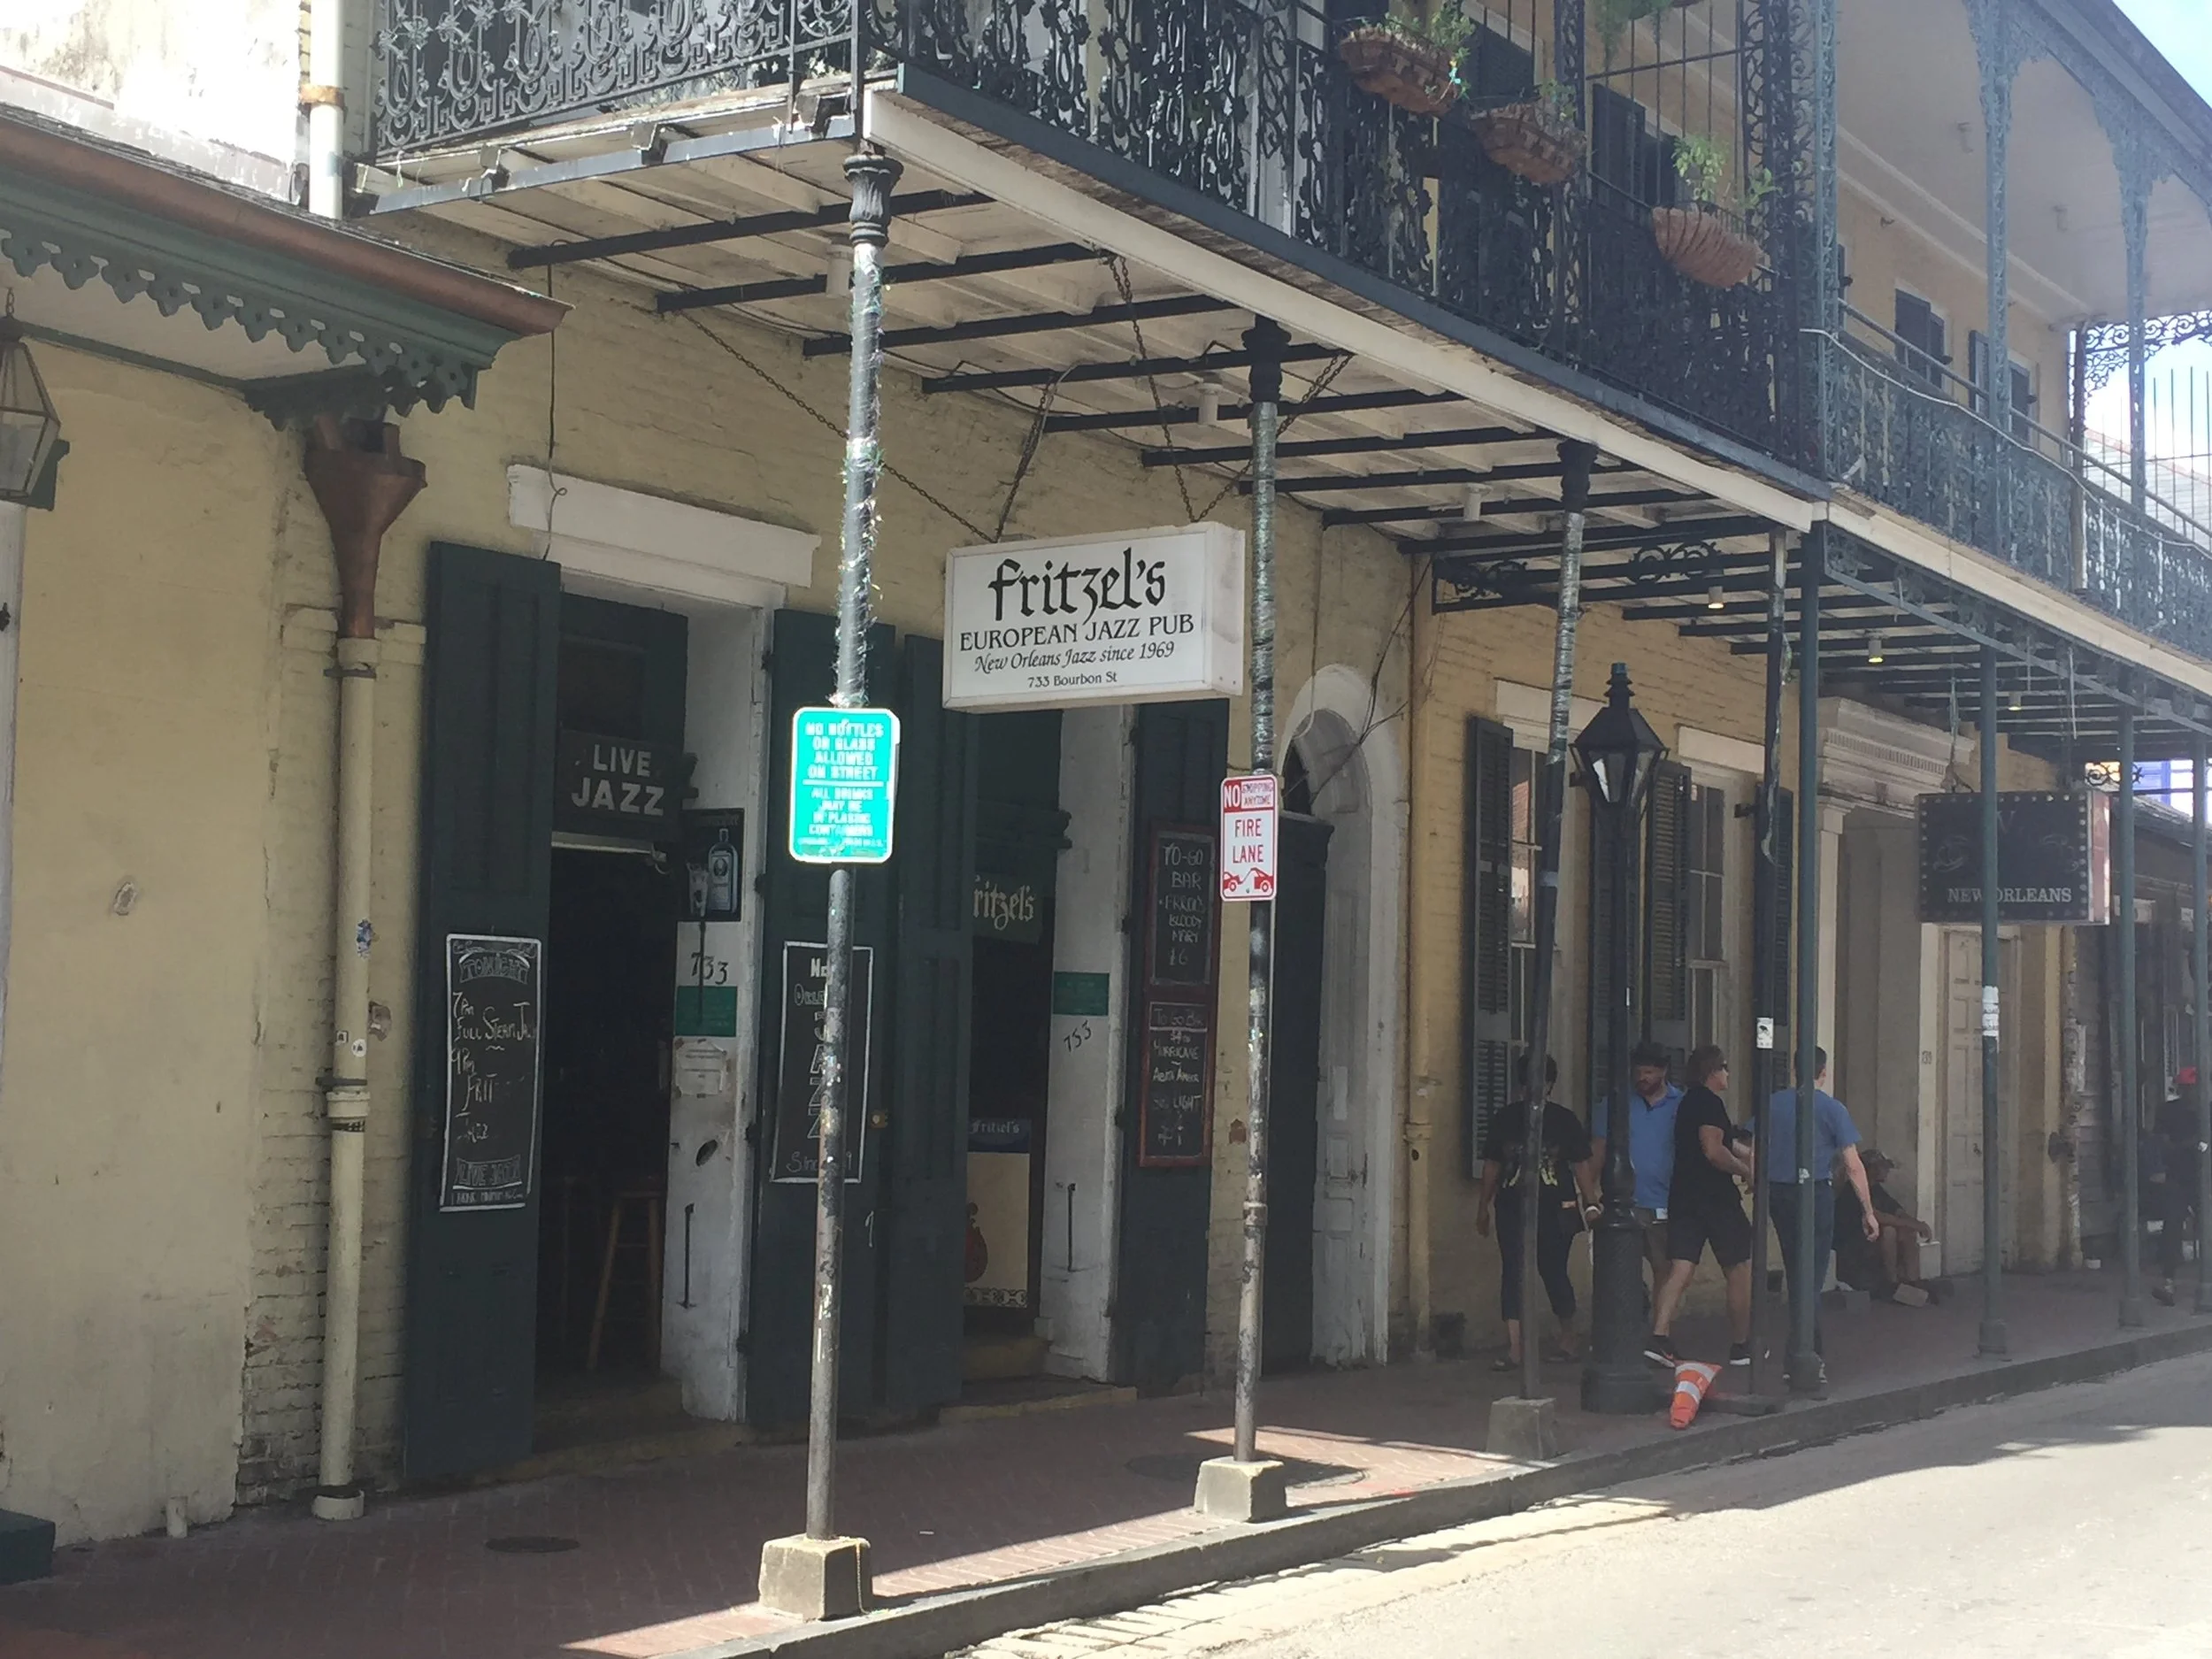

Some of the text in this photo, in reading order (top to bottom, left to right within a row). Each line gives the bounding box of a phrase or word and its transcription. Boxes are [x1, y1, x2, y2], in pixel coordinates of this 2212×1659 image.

[960, 613, 1194, 651] EUROPEAN JAZZ PUB
[974, 641, 1174, 674] New Orleans Jazz since 1969
[1027, 671, 1118, 688] 733 Bourbon St
[593, 743, 652, 777] LIVE
[815, 751, 874, 765] ALLOWED
[831, 766, 879, 780] STREET
[572, 777, 664, 817] JAZZ
[1225, 785, 1240, 809] NO
[1235, 818, 1262, 838] FIRE
[1233, 844, 1264, 864] LANE
[1171, 871, 1202, 890] BAR
[972, 873, 1034, 931] ritzel's
[810, 957, 828, 978] Ne
